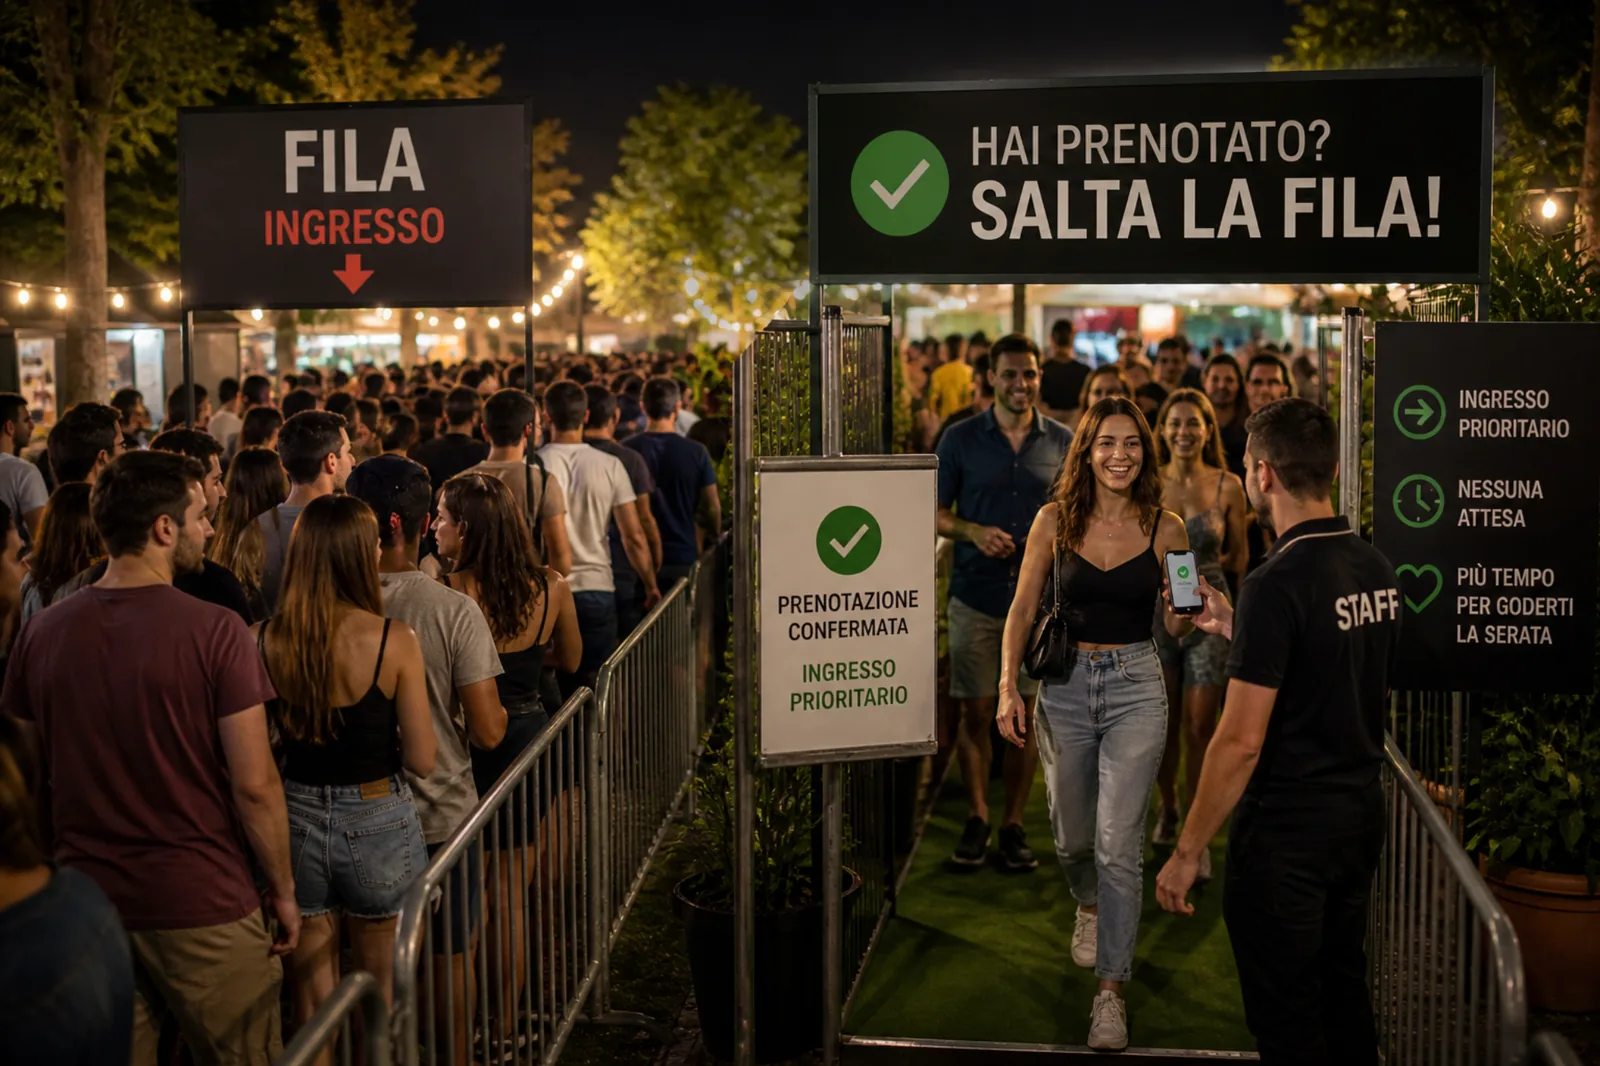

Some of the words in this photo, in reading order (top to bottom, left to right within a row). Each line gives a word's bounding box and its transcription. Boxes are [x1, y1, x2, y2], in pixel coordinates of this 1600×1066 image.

[972, 125, 1040, 166] HAI
[1056, 119, 1332, 165] PRENOTATO?
[285, 127, 425, 194] FILA
[970, 178, 1162, 241] SALTA
[1183, 177, 1262, 239] LA
[1284, 175, 1441, 239] FILA!
[264, 207, 445, 246] INGRESSO
[1459, 389, 1550, 409] INGRESSO
[1459, 418, 1570, 438] PRIORITARIO
[1458, 479, 1544, 499] NESSUNA
[1457, 508, 1526, 527] ATTESA
[1457, 563, 1487, 587] PIÙ
[1492, 567, 1555, 588] TEMPO
[778, 590, 919, 615] PRENOTAZIONE
[1335, 588, 1399, 631] STAFF
[1457, 596, 1491, 615] PER
[1496, 596, 1574, 616] GODERTI
[788, 617, 909, 641] CONFERMATA
[1456, 625, 1479, 644] LA
[1484, 625, 1553, 645] SERATA
[802, 659, 896, 683] INGRESSO
[790, 686, 908, 712] PRIORITARIO
